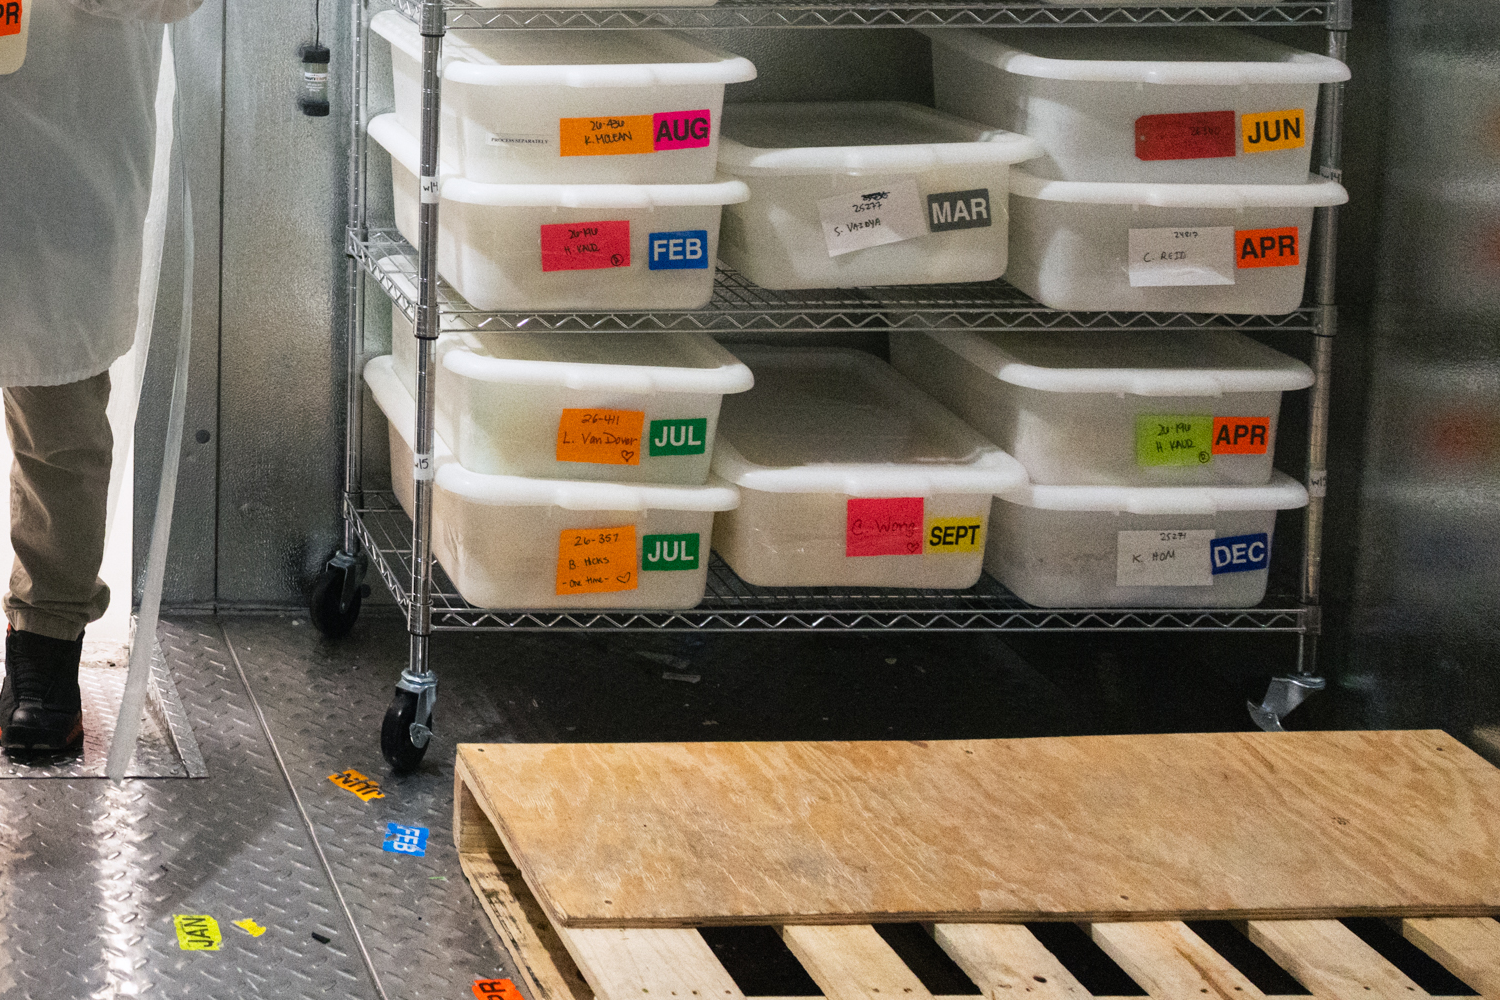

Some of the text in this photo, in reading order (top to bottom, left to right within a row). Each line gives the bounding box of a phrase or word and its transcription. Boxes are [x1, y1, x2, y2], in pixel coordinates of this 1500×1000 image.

[656, 118, 708, 142] AUG
[1248, 118, 1300, 144] JUN
[932, 198, 988, 224] MAR
[654, 238, 702, 261] FEB
[1241, 235, 1295, 260] APR
[655, 426, 701, 447] JUL
[1215, 425, 1266, 446] APR
[929, 525, 980, 546] SEPT
[647, 541, 694, 562] JUL
[1214, 541, 1265, 567] DEC
[393, 825, 420, 853] FEB
[182, 918, 214, 947] JAN
